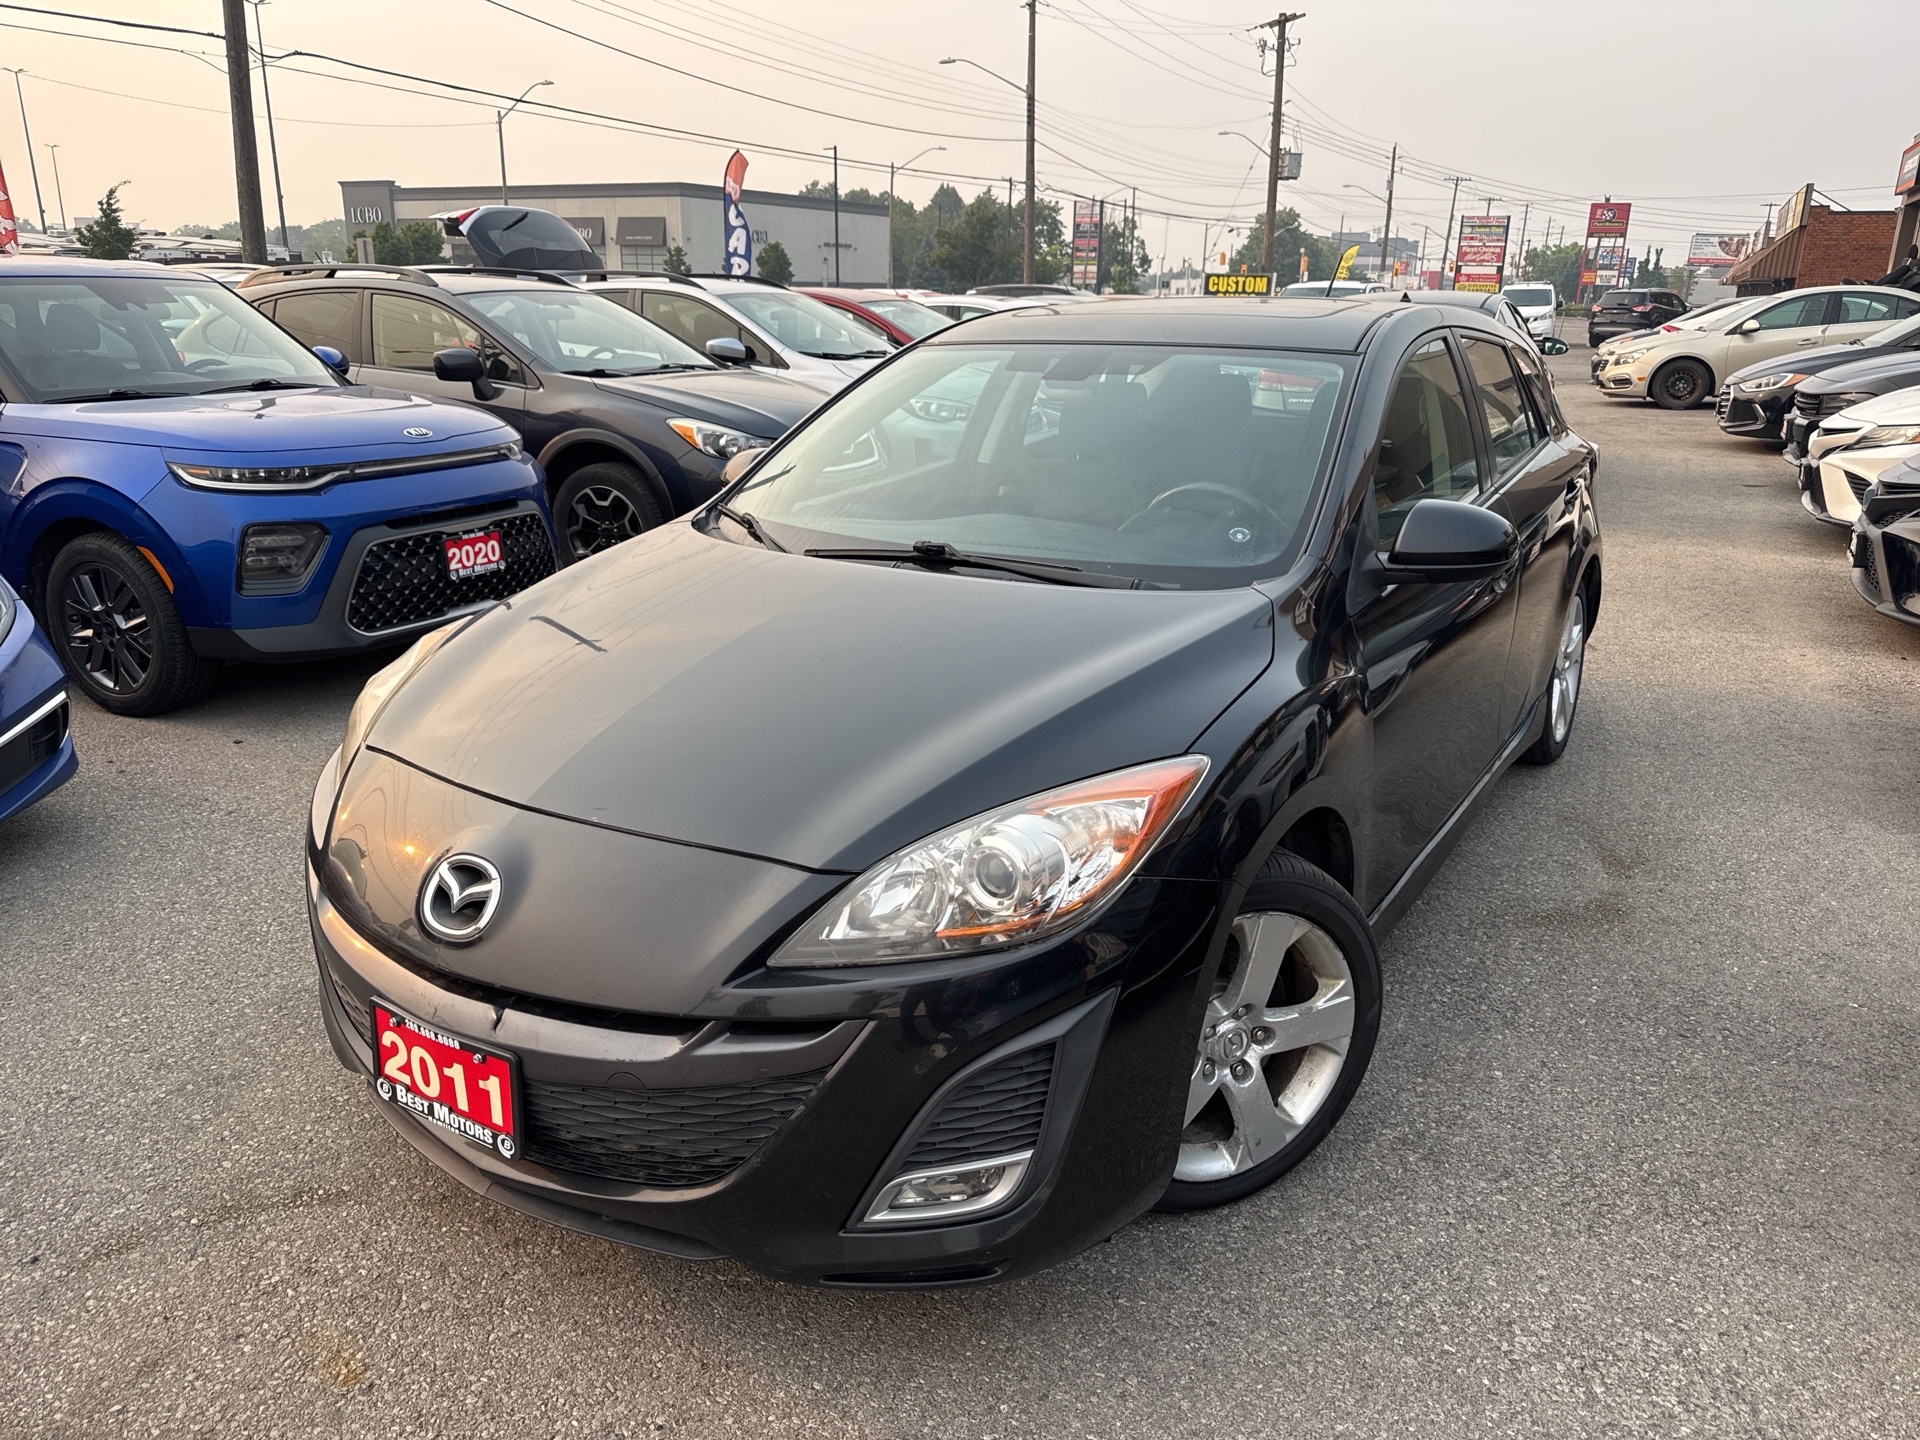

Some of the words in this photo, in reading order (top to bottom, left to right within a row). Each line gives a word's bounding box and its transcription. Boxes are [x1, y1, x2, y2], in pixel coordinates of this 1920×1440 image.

[351, 206, 382, 224] LCBO
[751, 230, 768, 243] CBO
[1208, 276, 1268, 293] CUSTOM
[404, 427, 432, 438] KIA
[447, 540, 500, 571] 2020
[459, 568, 473, 576] BEST
[474, 562, 498, 573] MOTORS
[381, 1030, 504, 1127] 2011
[395, 1084, 430, 1115] BEST
[433, 1101, 494, 1144] MOTORS
